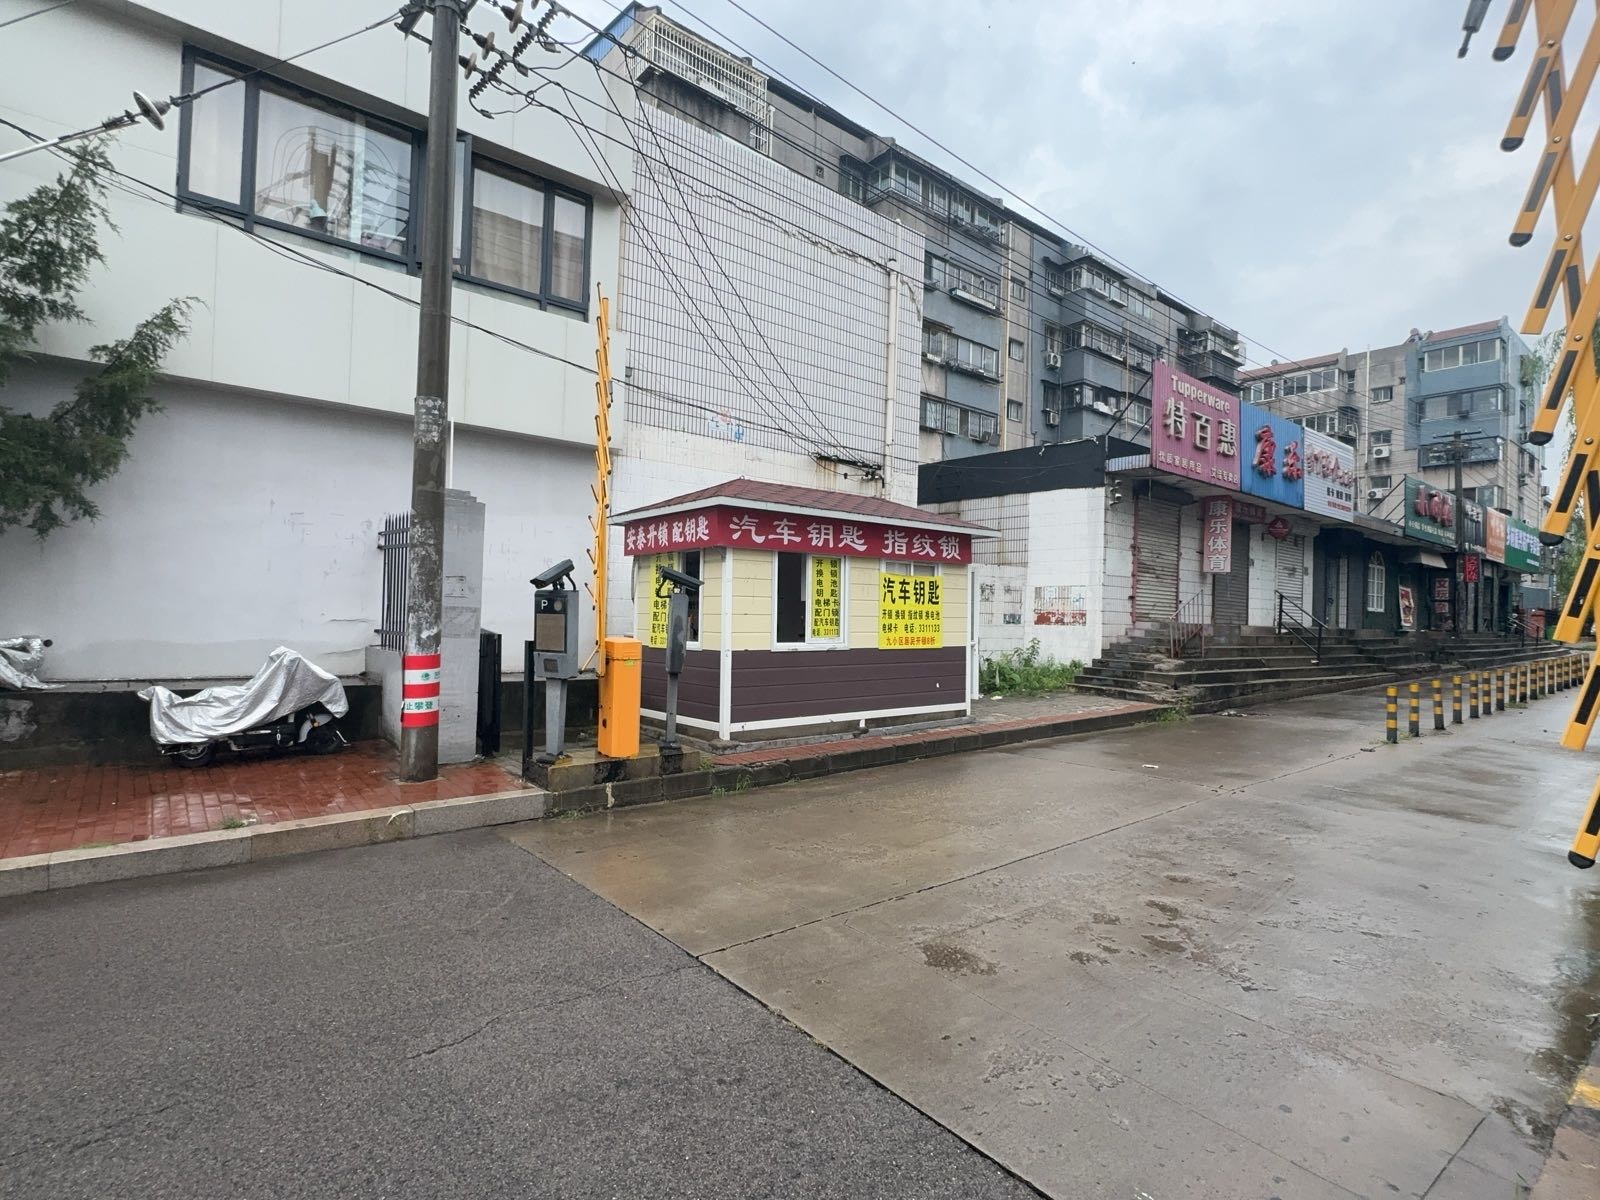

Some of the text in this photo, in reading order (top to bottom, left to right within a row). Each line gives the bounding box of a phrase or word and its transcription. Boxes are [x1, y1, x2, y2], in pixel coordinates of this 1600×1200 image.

[1171, 374, 1231, 413] Tupperware
[1163, 397, 1238, 456] 特百惠
[626, 515, 710, 551] 安泰开锁 配钥匙
[729, 514, 962, 560] 汽车钥匙 指纹锁
[1207, 500, 1228, 571] 康乐体育
[541, 599, 549, 610] P
[882, 577, 940, 605] 汽车钥匙
[881, 623, 899, 634] 电梯卡
